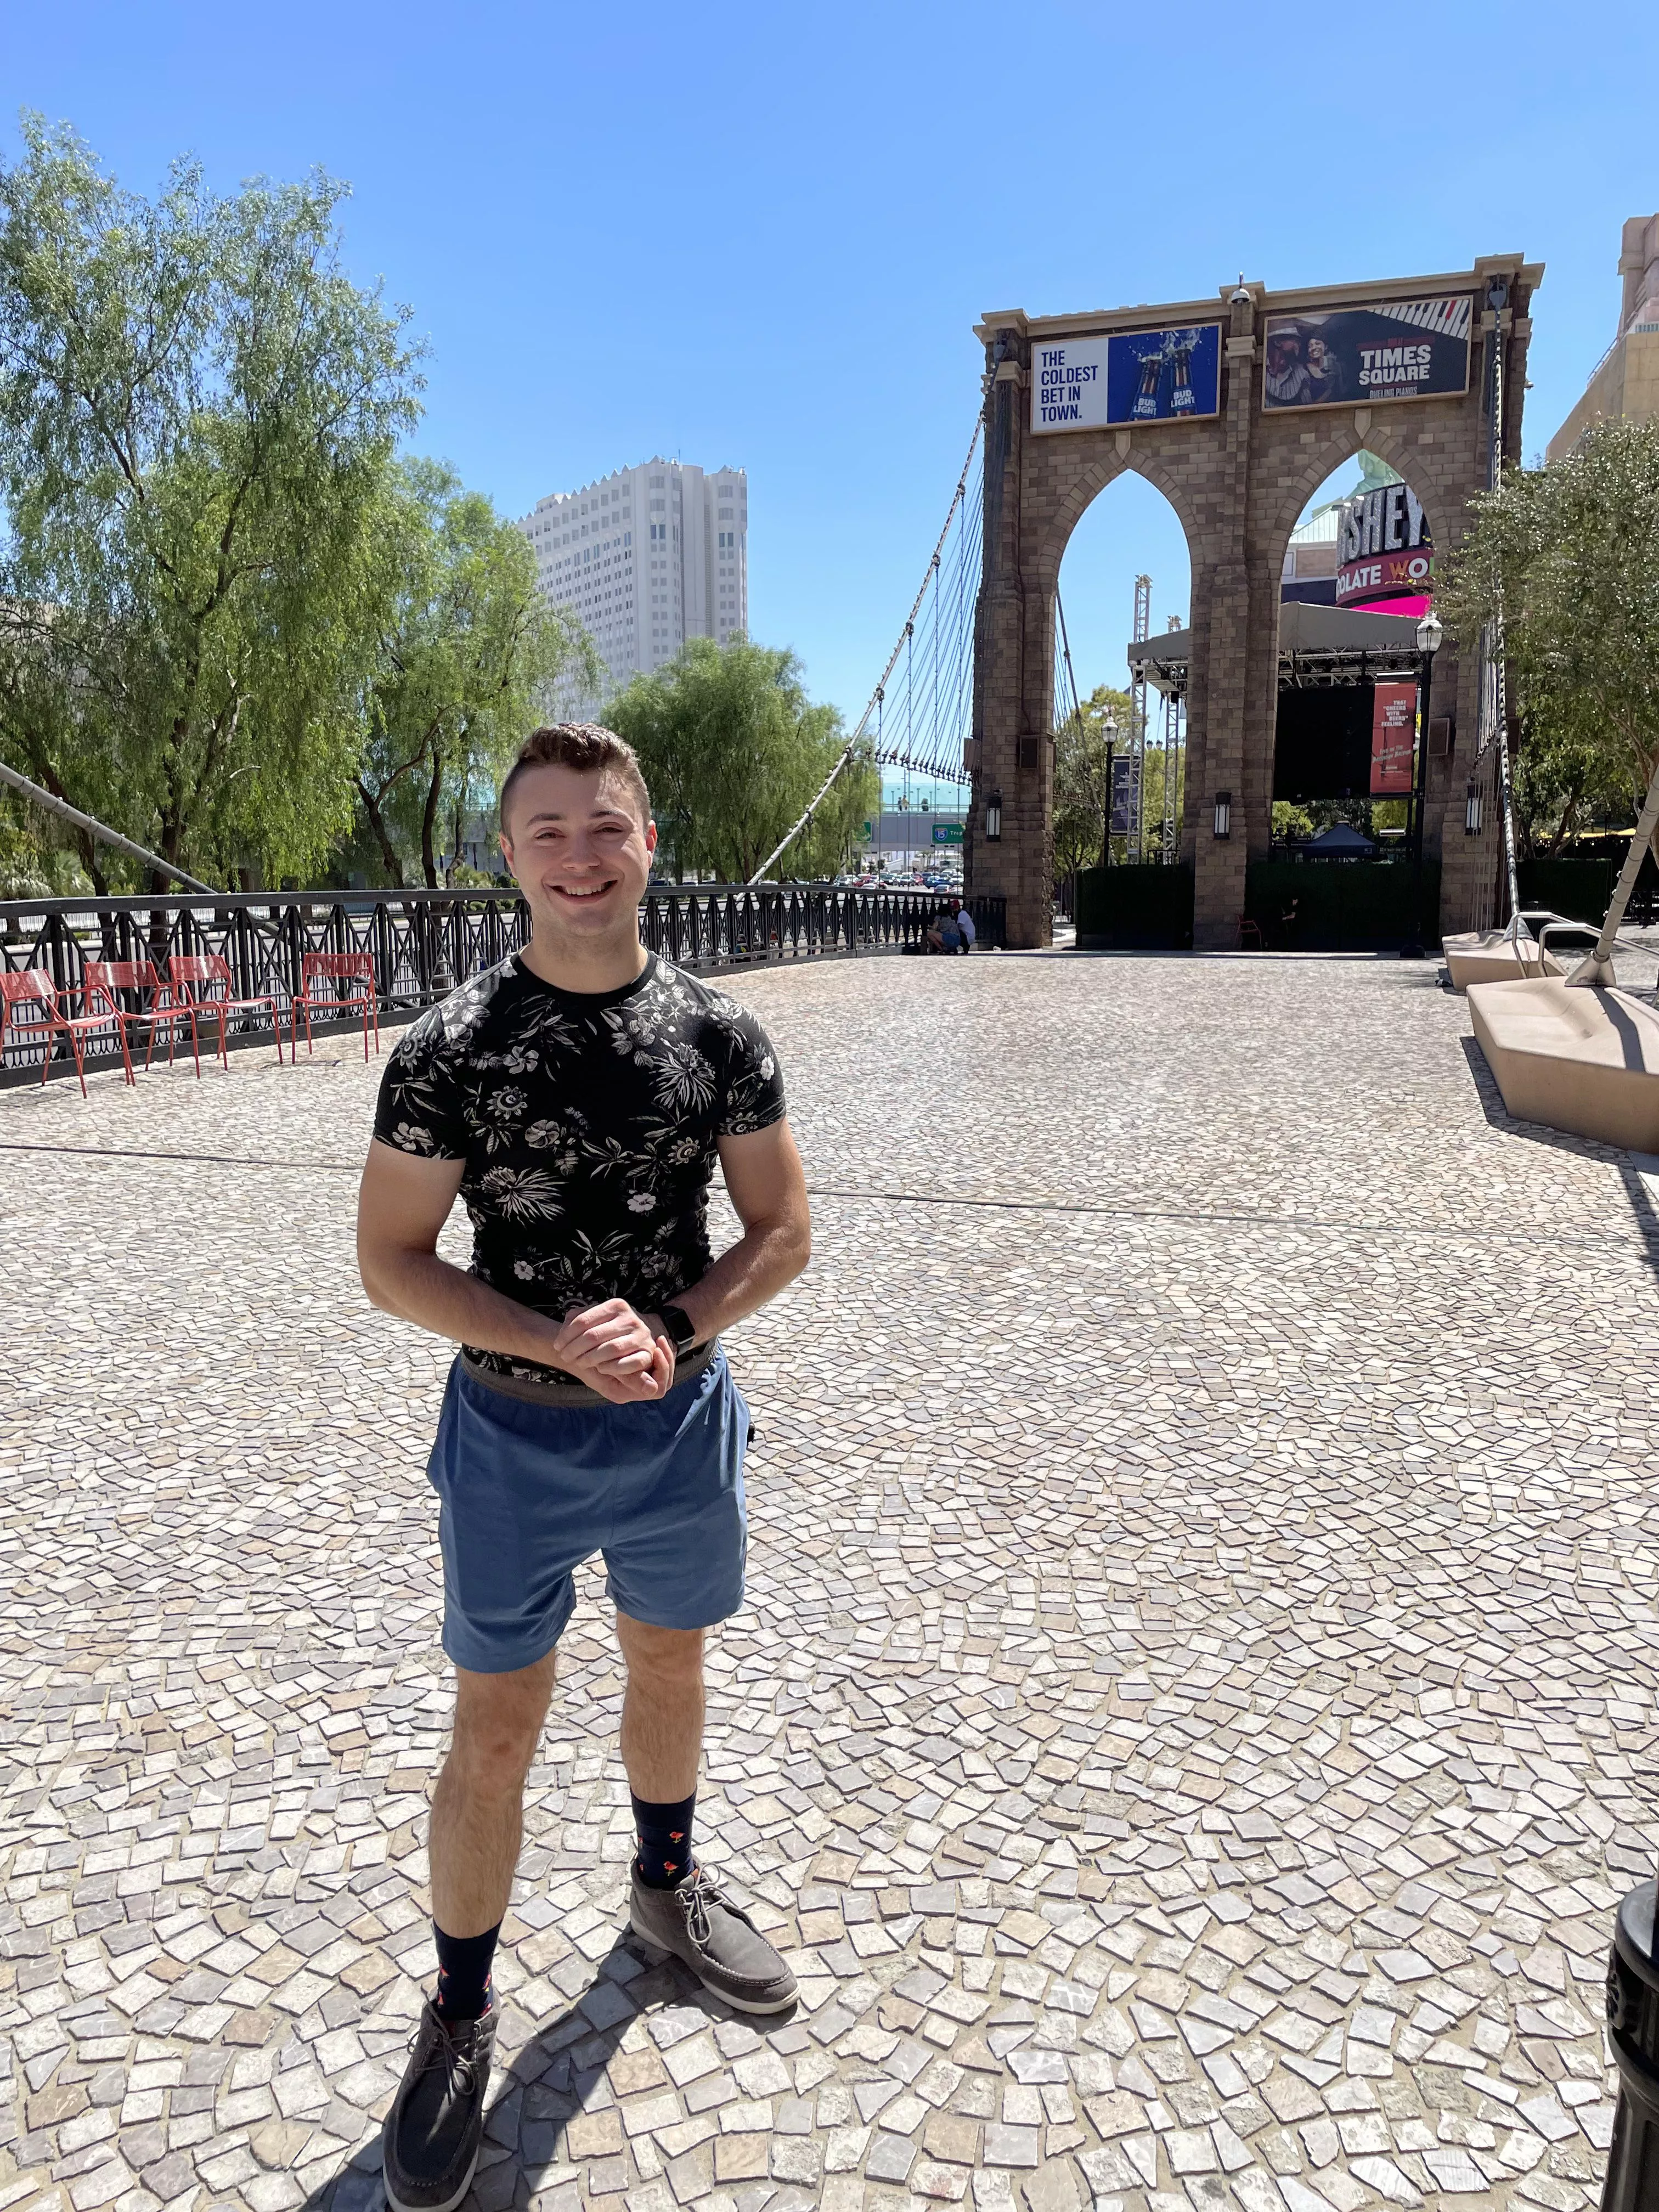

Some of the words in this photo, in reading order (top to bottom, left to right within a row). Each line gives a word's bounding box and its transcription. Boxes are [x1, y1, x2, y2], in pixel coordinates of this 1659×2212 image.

[1041, 350, 1065, 367] THE
[1360, 345, 1431, 369] TIMES
[1041, 365, 1098, 385] COLDEST
[1359, 364, 1430, 385] SQUARE
[1041, 387, 1065, 404] BET
[1068, 386, 1080, 401] IN
[1173, 390, 1192, 399] BUD
[1396, 386, 1418, 397] PIANOS
[1133, 405, 1157, 415] LIGHT
[1138, 398, 1156, 407] BUD
[1171, 396, 1195, 408] LIGHT
[1041, 404, 1082, 422] TOWN.
